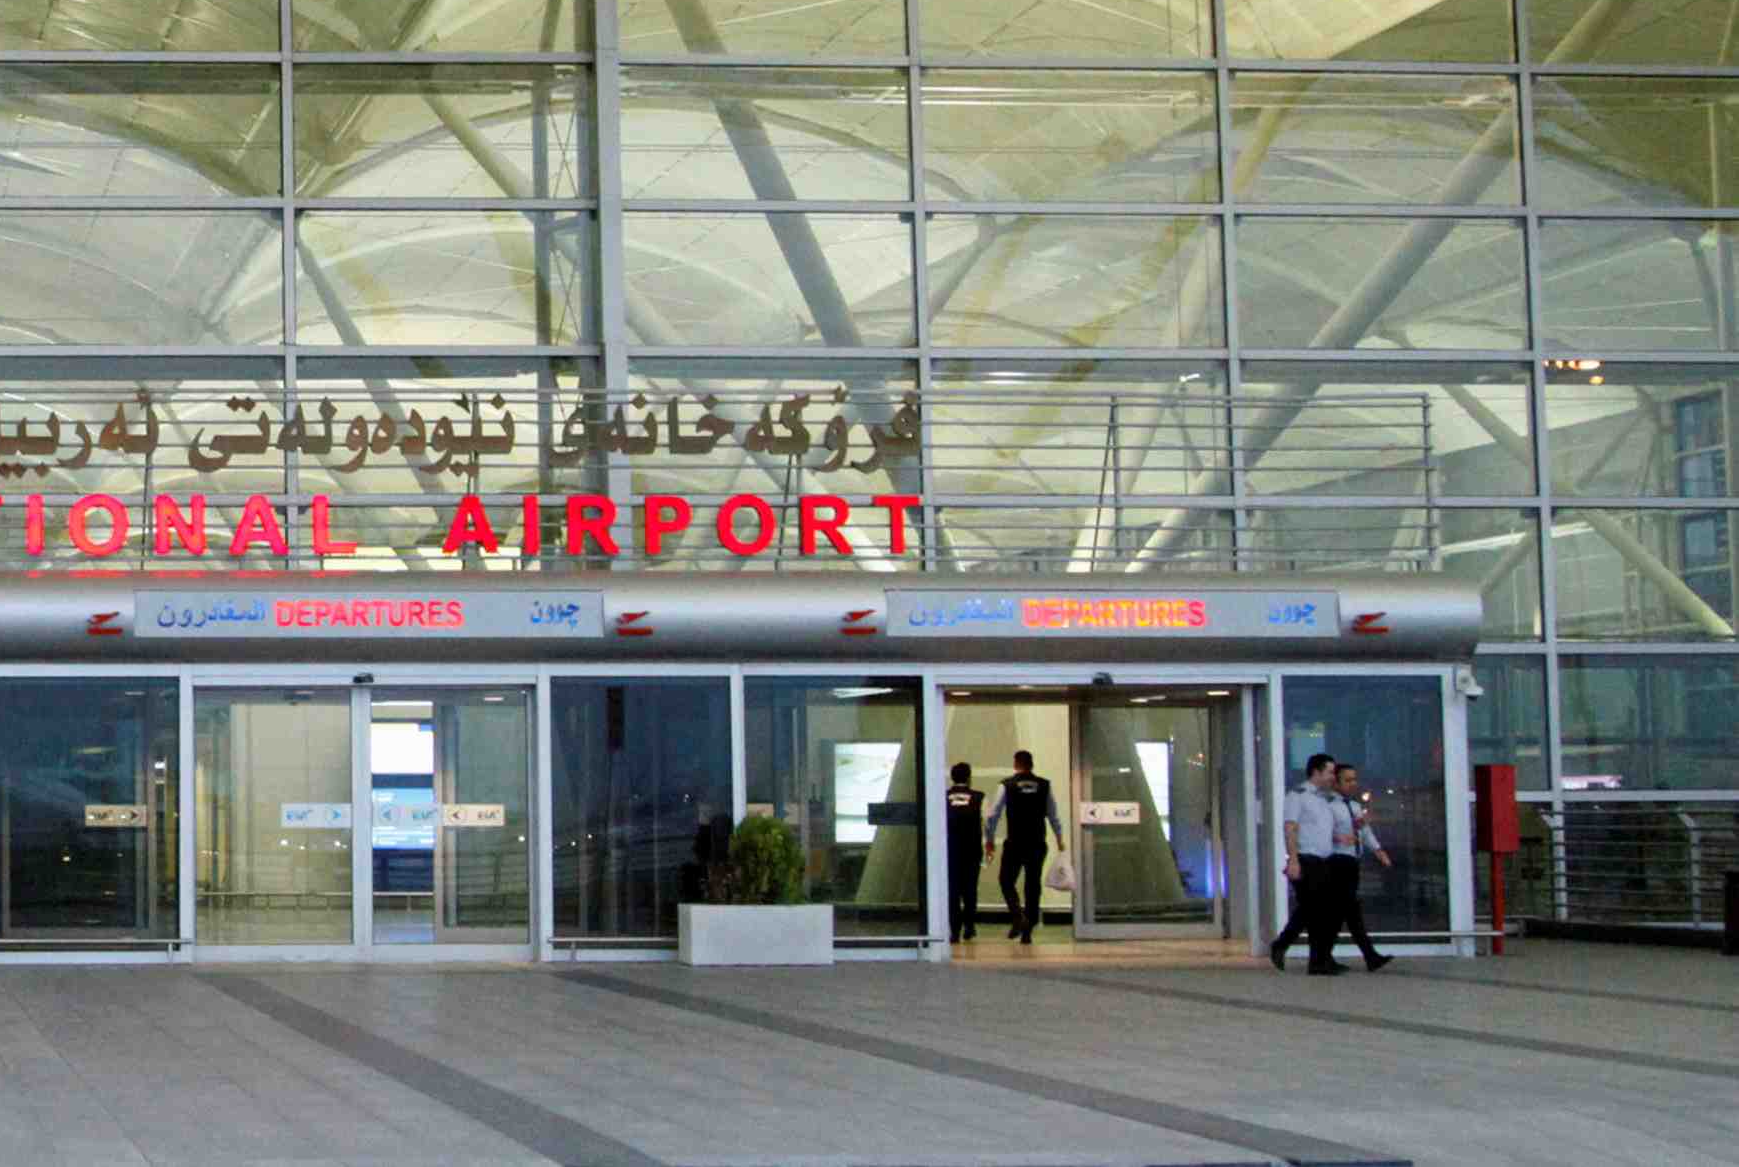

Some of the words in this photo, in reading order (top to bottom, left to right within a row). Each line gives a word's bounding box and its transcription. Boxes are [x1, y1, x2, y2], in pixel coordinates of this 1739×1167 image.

[442, 493, 921, 556] AIRPORT
[276, 600, 464, 628] DEPARTURES
[1020, 598, 1206, 628] DEPARTURES
